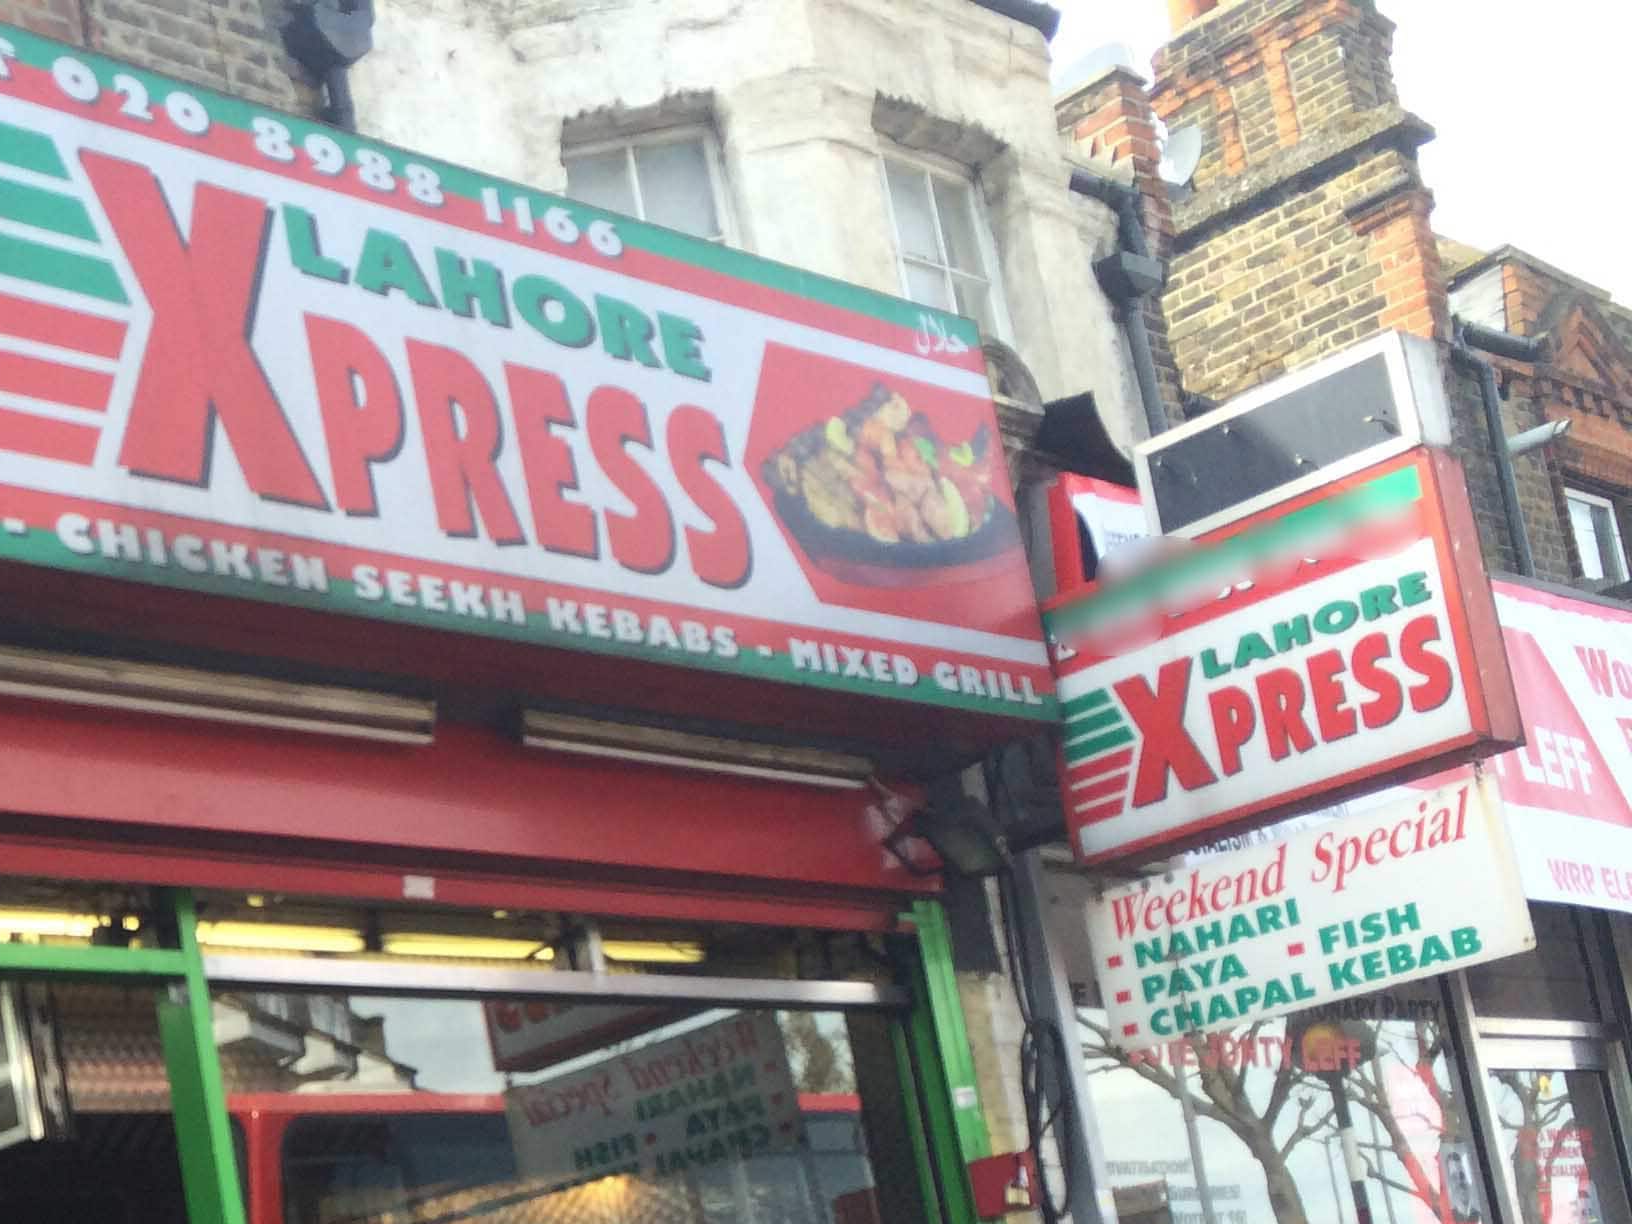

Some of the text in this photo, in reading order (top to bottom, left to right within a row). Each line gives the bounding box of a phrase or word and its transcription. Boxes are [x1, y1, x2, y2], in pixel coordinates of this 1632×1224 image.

[53, 56, 624, 258] 020 8988 1166
[283, 203, 712, 383] LAHORE
[77, 147, 753, 590] XPRESS
[57, 514, 329, 594] CHICKEN
[352, 566, 526, 626] SEEKH
[547, 597, 739, 658] KEBABS
[789, 637, 919, 687] MIXED
[932, 661, 1044, 706] GRILL
[1201, 571, 1433, 680] LAHORE
[1113, 615, 1454, 809] XPRESS
[1524, 726, 1593, 794] LEFF
[1111, 844, 1286, 940] Weekend
[1311, 785, 1469, 892] Special
[1547, 858, 1596, 896] WRP
[1134, 898, 1420, 969] NAHARI FISH
[1140, 953, 1248, 1004] PAYA
[1148, 926, 1484, 1038] CHAPAL KEBAB
[1301, 1036, 1361, 1072] LEFF
